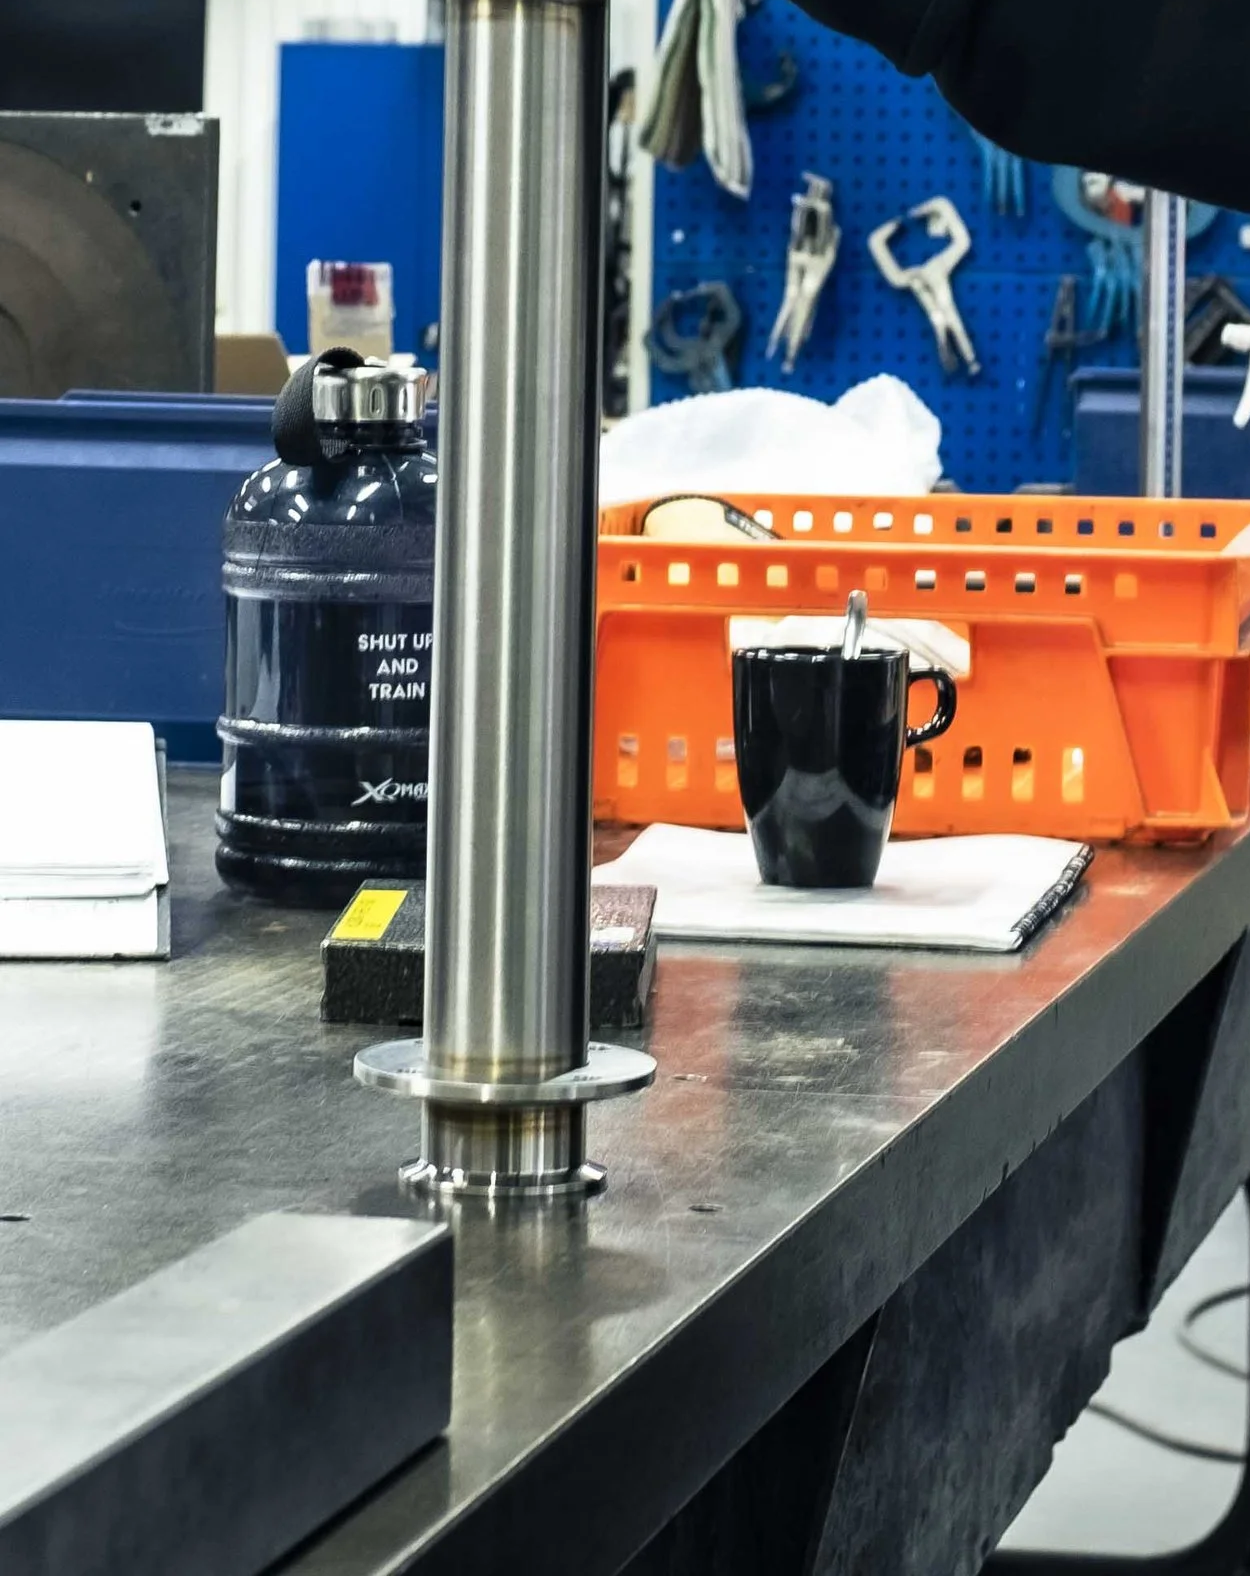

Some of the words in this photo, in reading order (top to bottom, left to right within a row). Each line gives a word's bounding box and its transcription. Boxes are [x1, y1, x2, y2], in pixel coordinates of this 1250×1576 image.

[358, 633, 408, 651] SHUT
[413, 632, 433, 650] UP
[376, 658, 419, 676] AND
[368, 682, 426, 700] TRAIN
